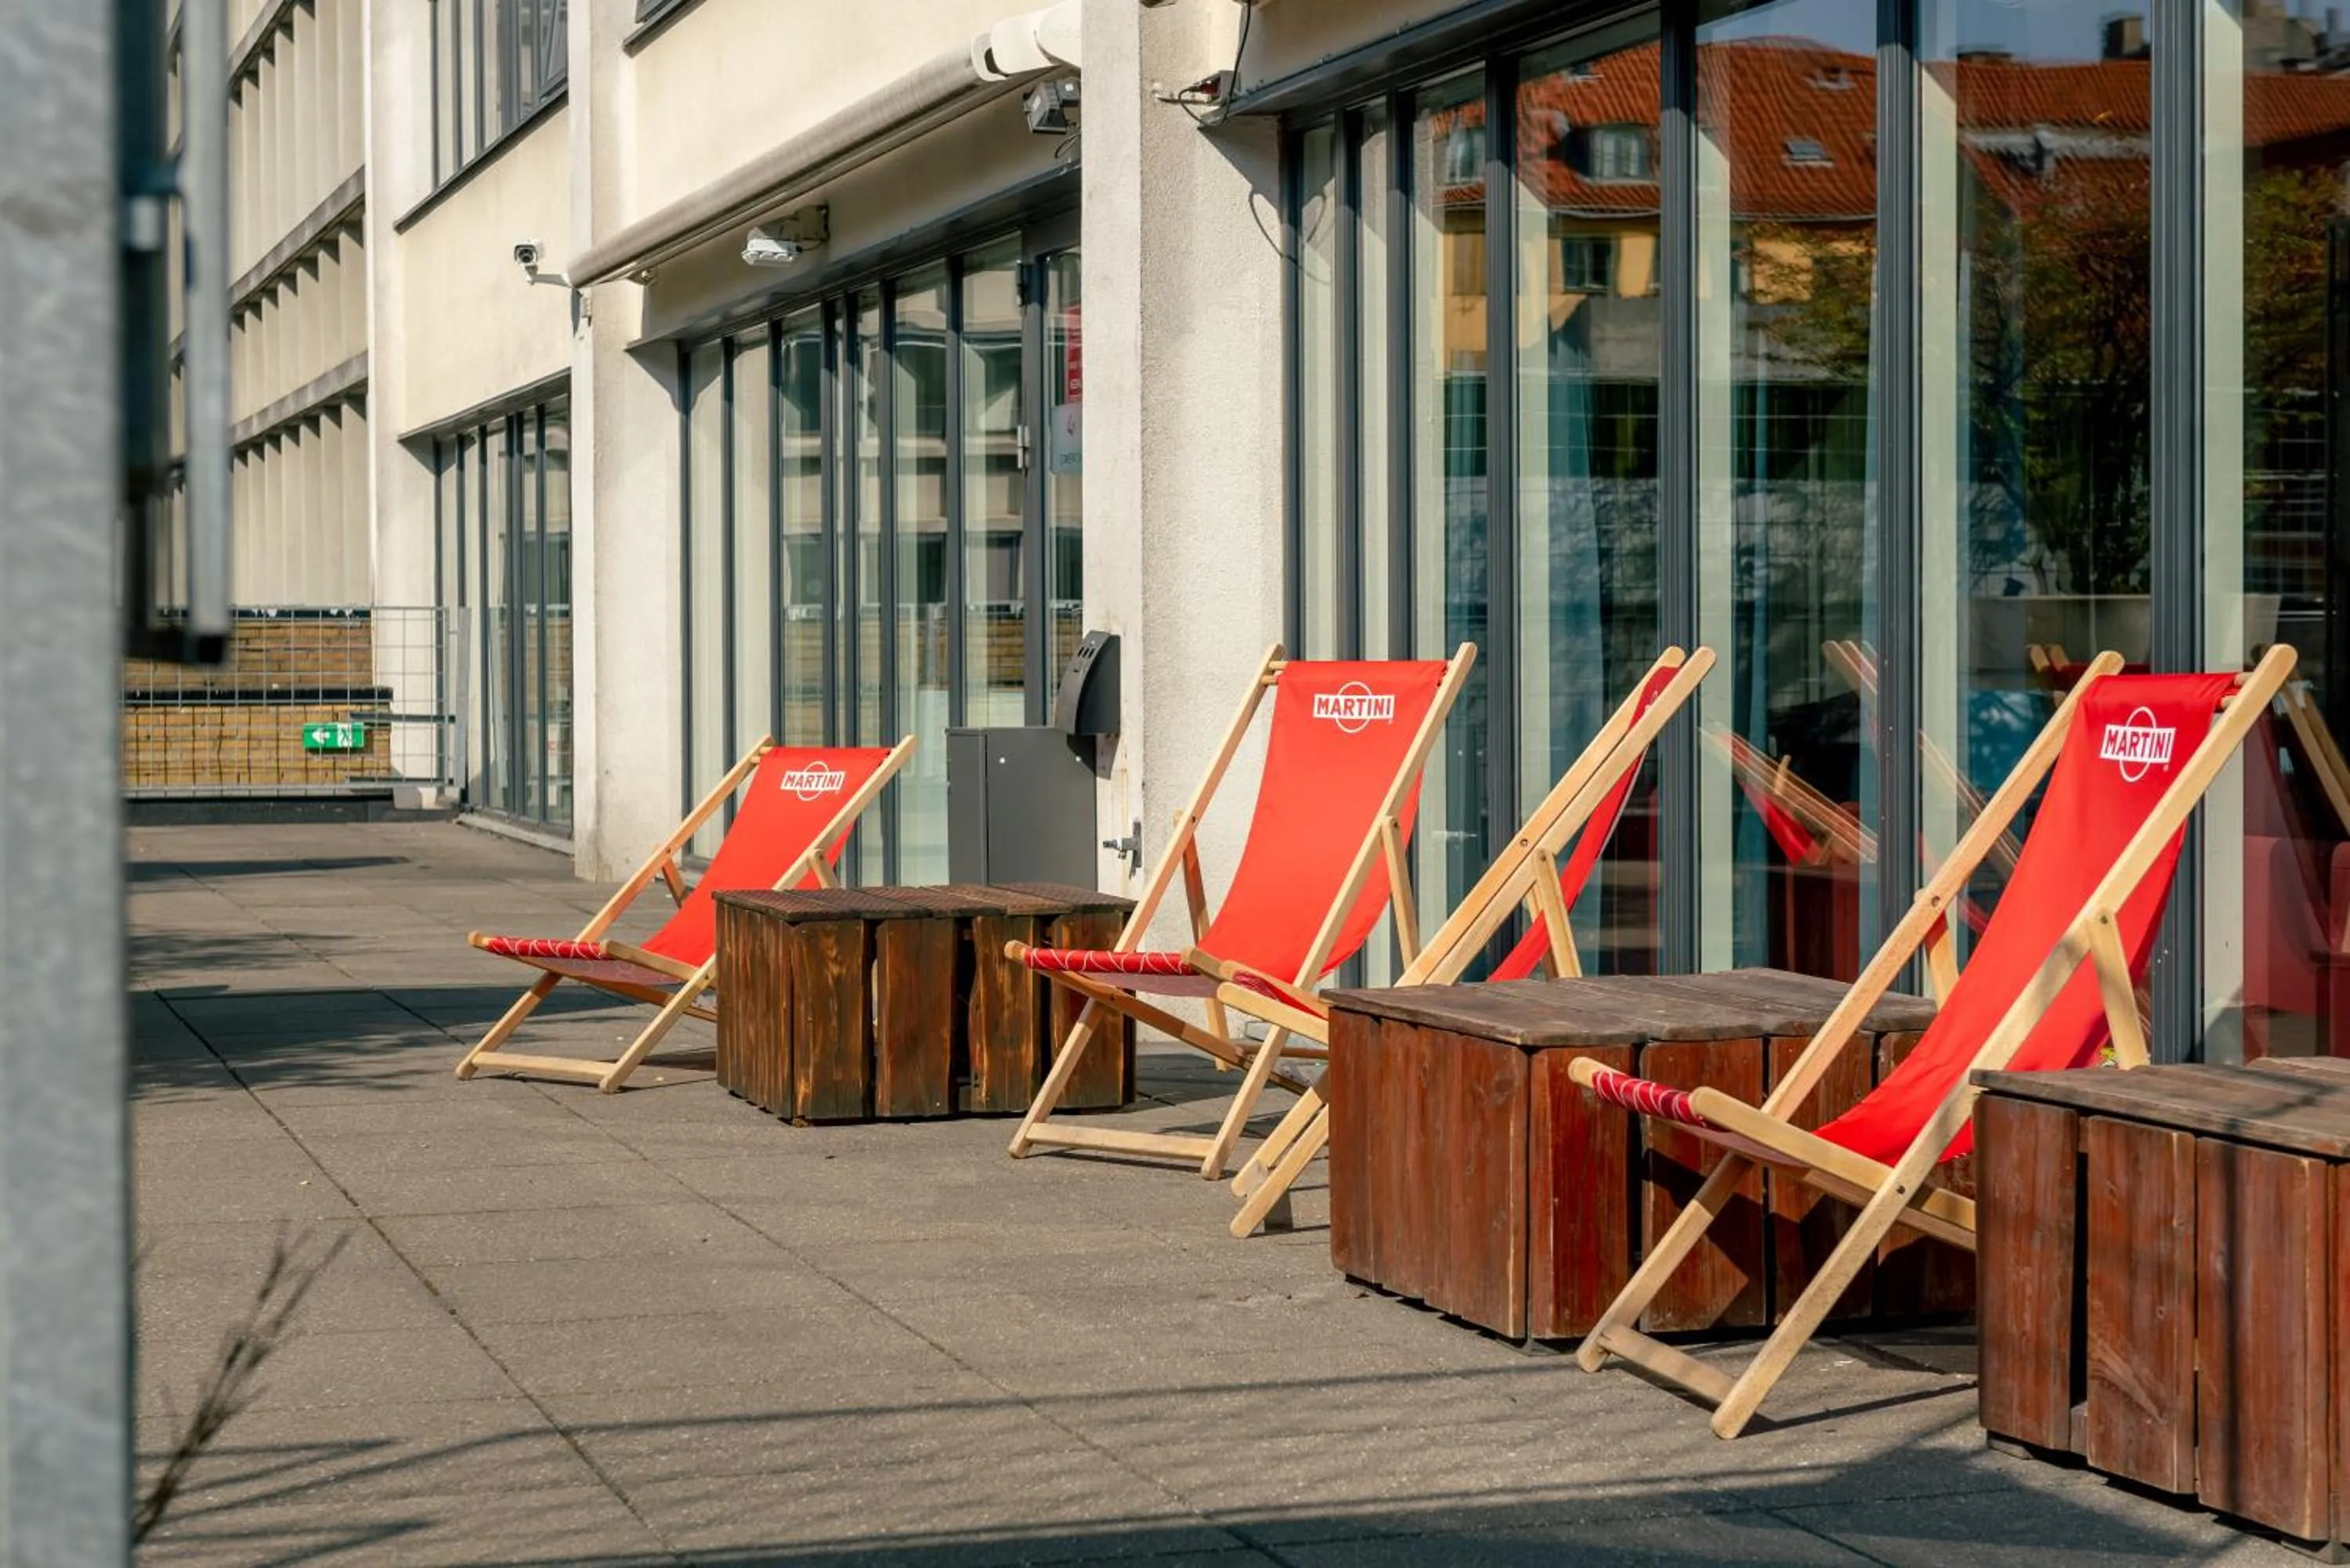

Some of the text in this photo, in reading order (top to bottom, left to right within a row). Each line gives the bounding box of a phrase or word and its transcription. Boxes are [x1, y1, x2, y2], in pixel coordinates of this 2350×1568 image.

[1316, 696, 1392, 717] MARTINI
[2103, 728, 2172, 759] MARTINI
[784, 773, 842, 789] MARTINI
